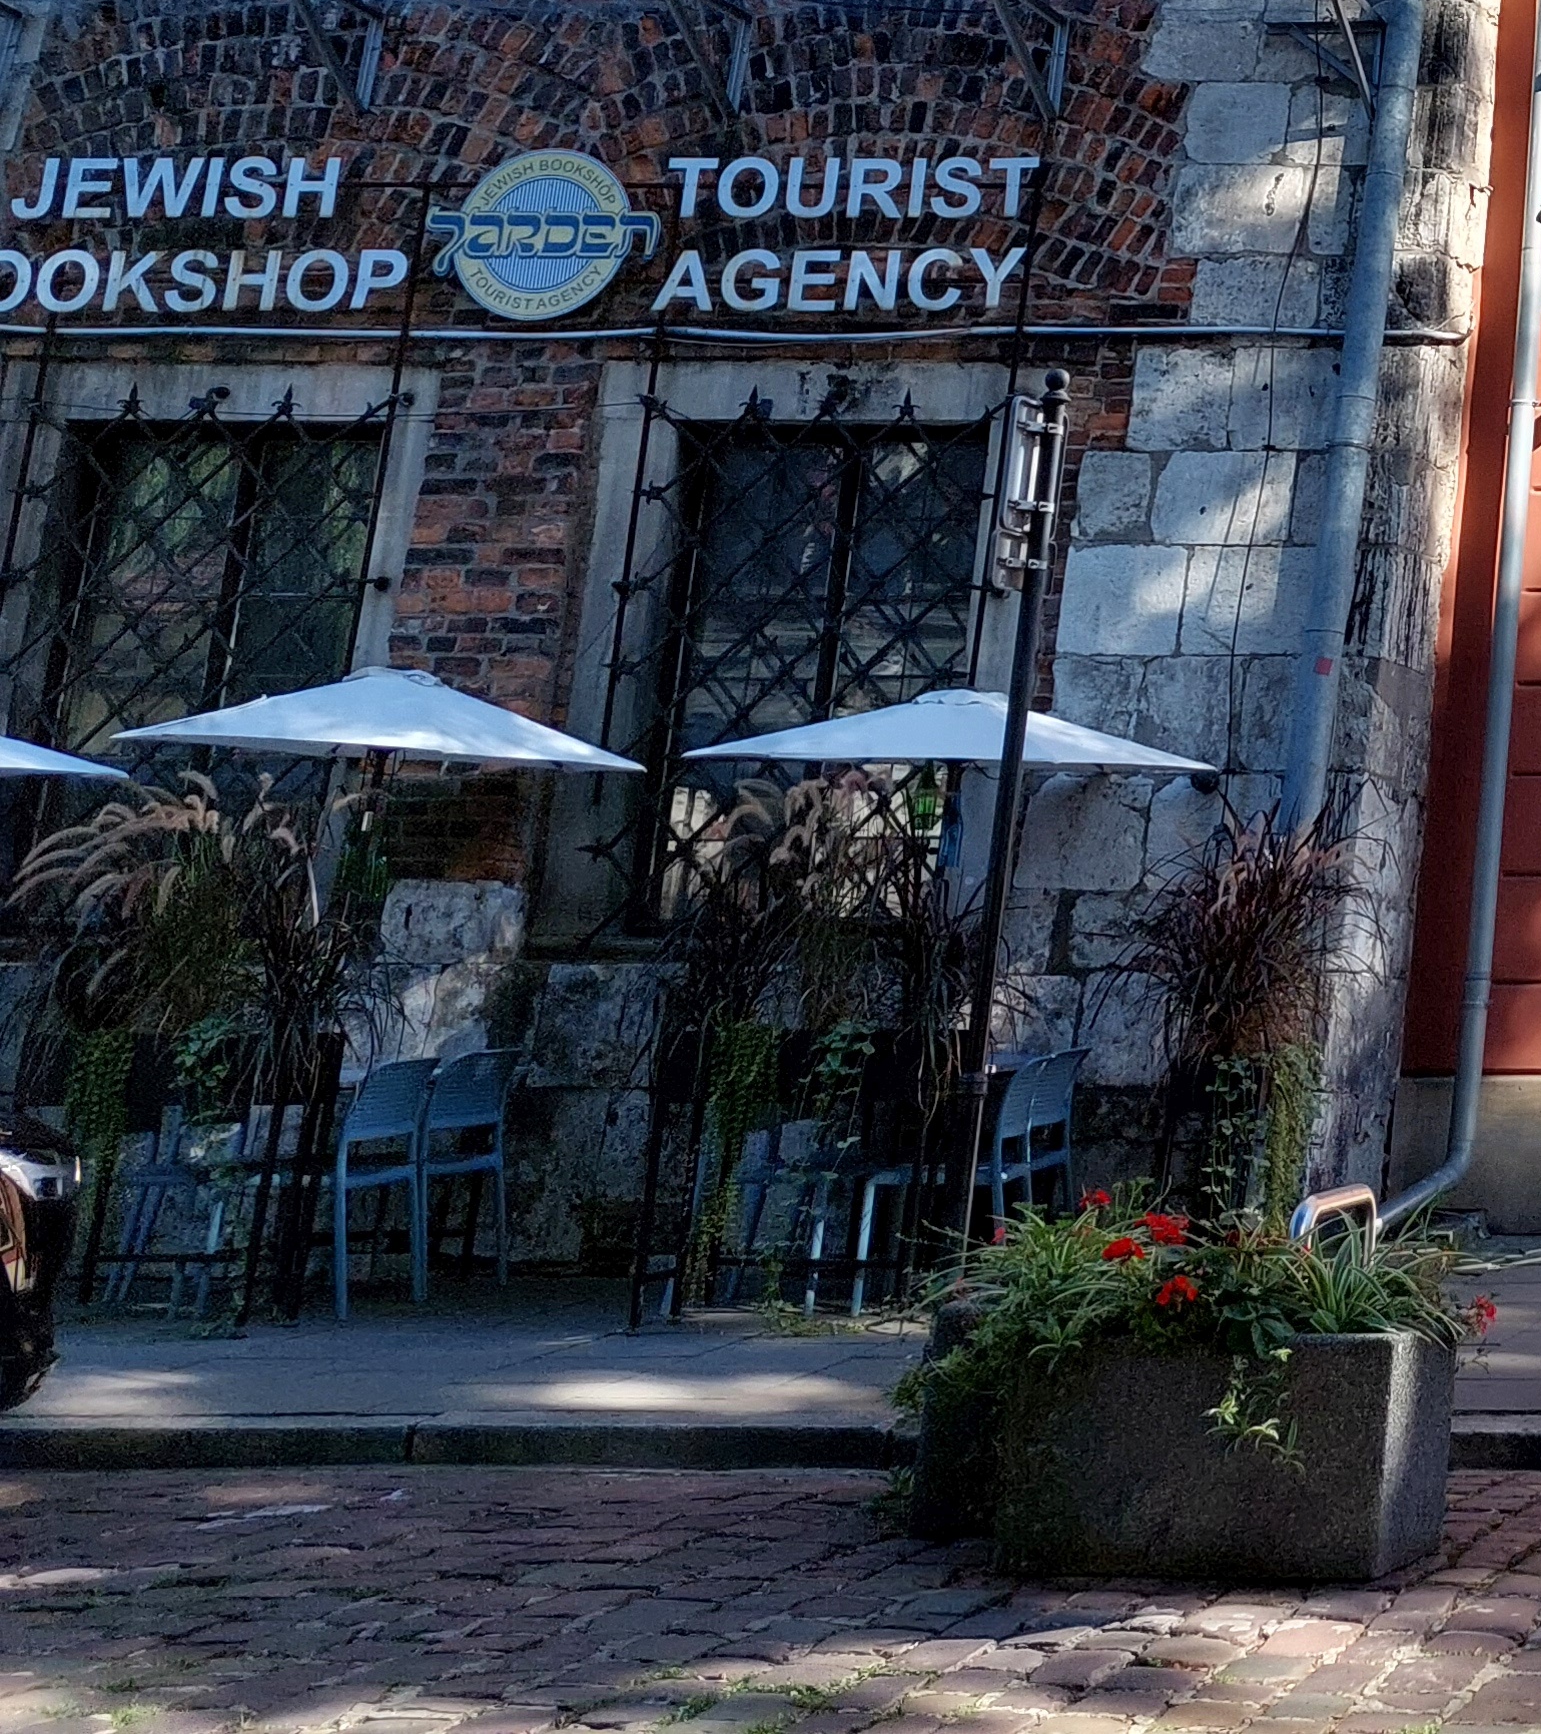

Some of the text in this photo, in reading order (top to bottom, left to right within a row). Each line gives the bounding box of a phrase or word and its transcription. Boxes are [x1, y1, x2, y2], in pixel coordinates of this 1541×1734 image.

[11, 156, 341, 219] JEWISH
[481, 158, 617, 206] JEWISH BOOKSHOP
[668, 156, 1040, 219] TOURIST
[470, 265, 603, 311] TOURIST AGENCY
[650, 247, 1027, 313] AGENCY
